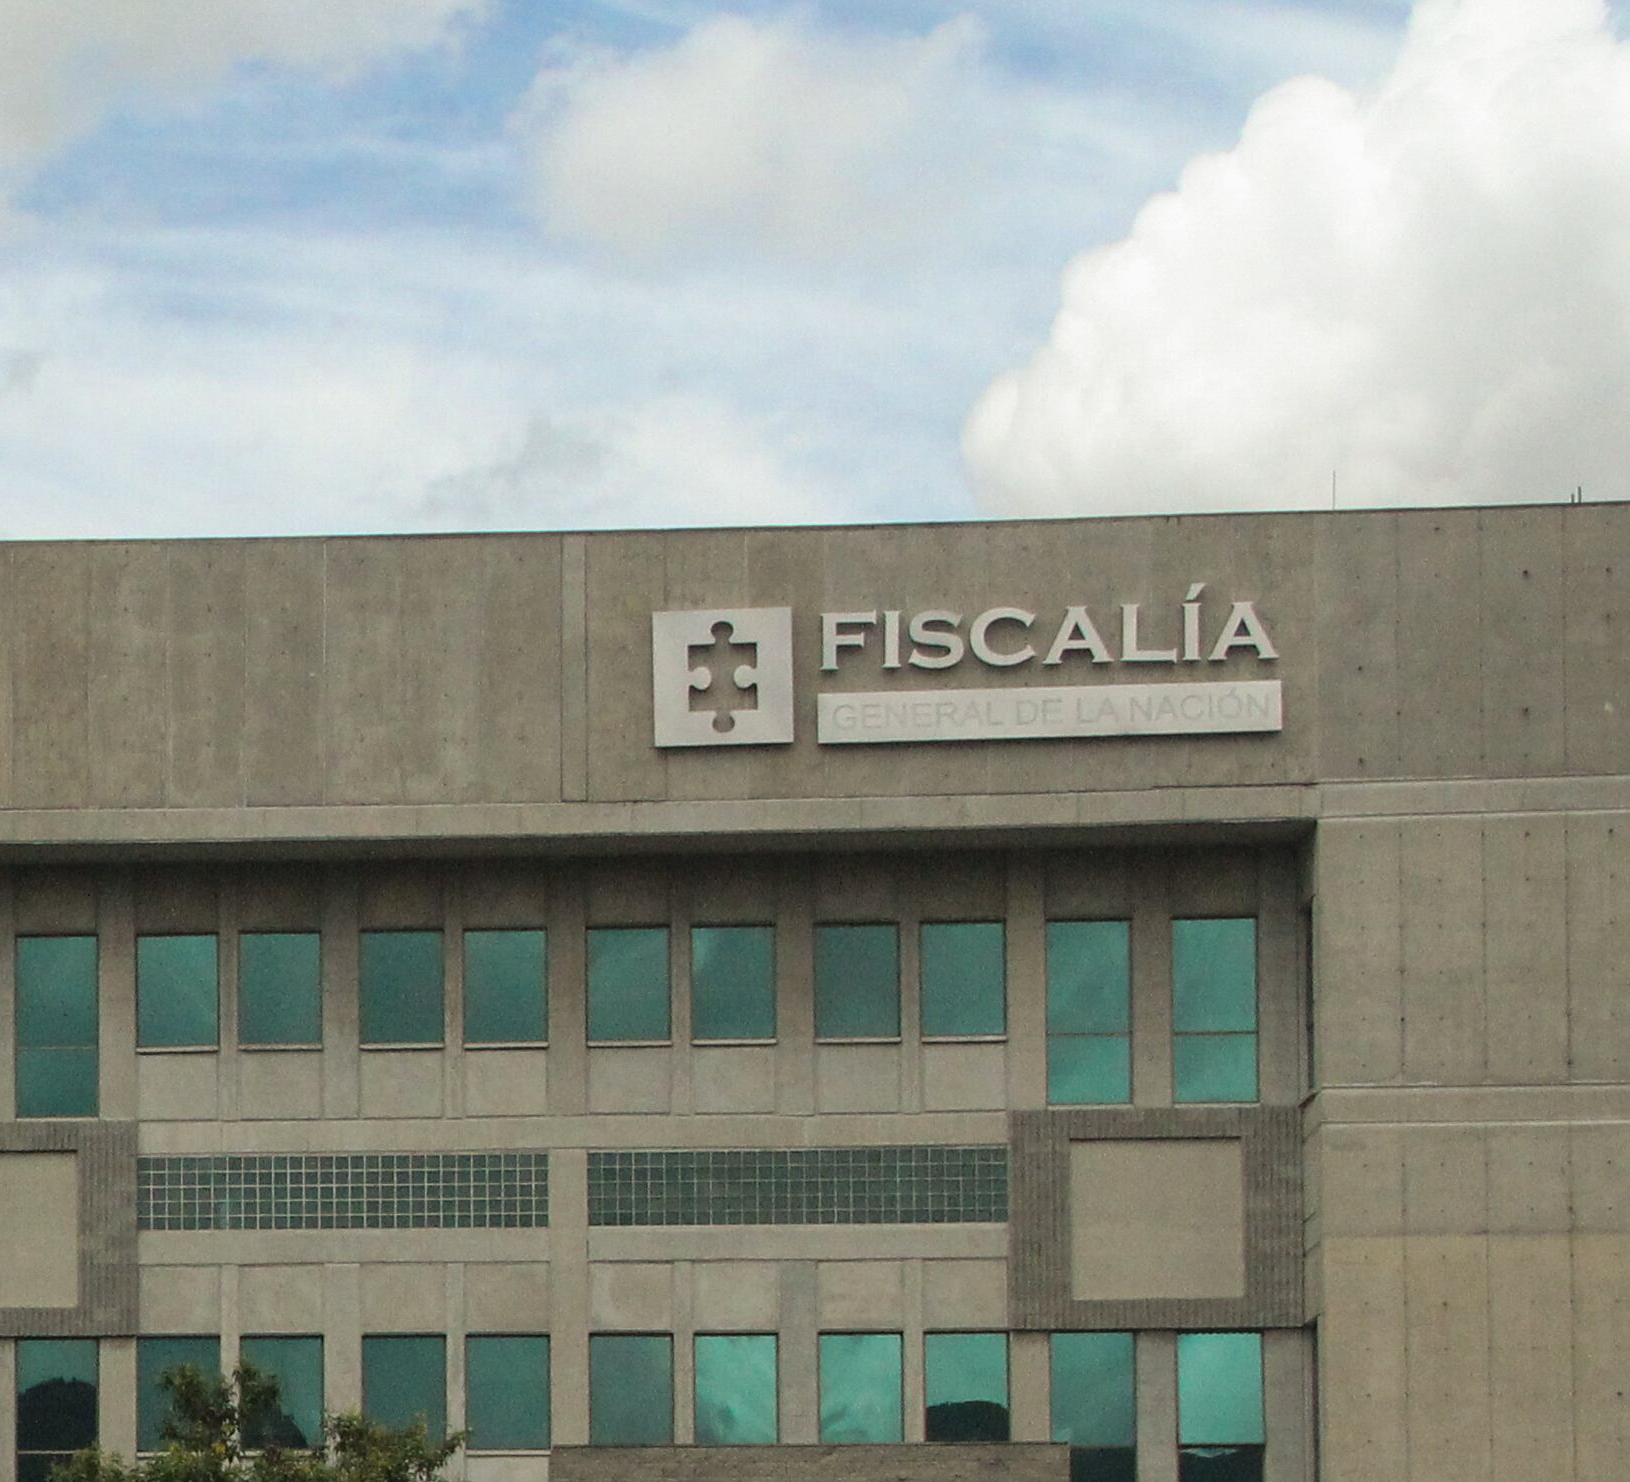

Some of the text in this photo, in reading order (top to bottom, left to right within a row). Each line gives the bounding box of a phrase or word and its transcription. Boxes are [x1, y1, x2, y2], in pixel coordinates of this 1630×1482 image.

[819, 582, 1280, 671] FISCALÍA
[831, 687, 1270, 732] GENERAL DE LA NACIÓN
